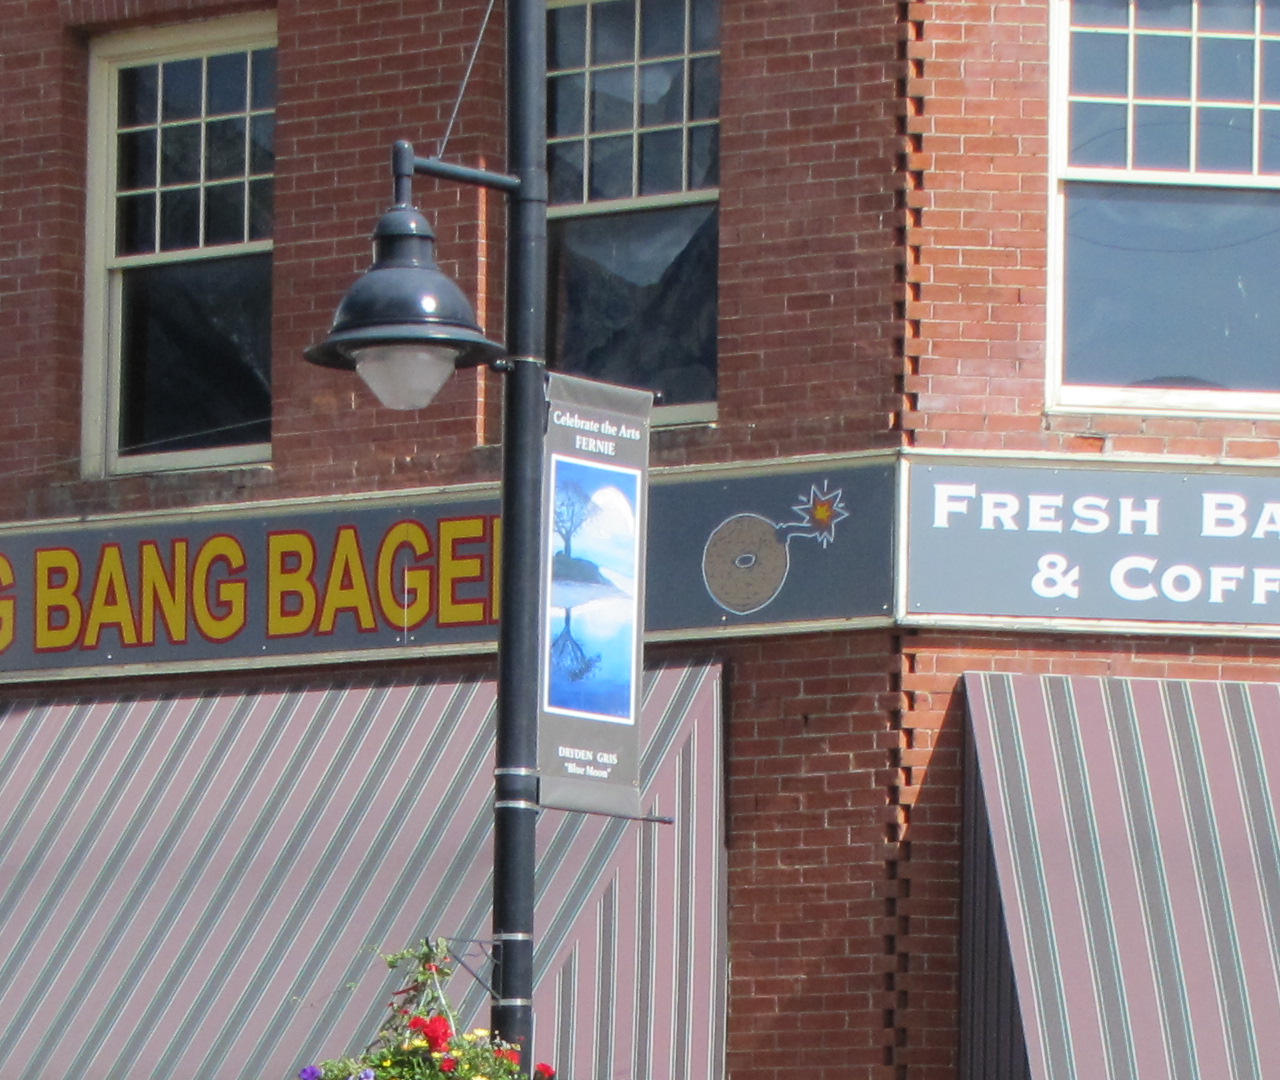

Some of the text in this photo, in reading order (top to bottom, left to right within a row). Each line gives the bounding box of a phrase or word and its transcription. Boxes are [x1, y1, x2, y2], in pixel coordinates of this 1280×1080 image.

[554, 411, 641, 440] Celebrate the Arts
[575, 435, 616, 456] FERNIE
[931, 483, 1160, 536] FRESH
[34, 534, 249, 655] BANG
[266, 514, 501, 639] BAGE
[1031, 553, 1080, 600] &
